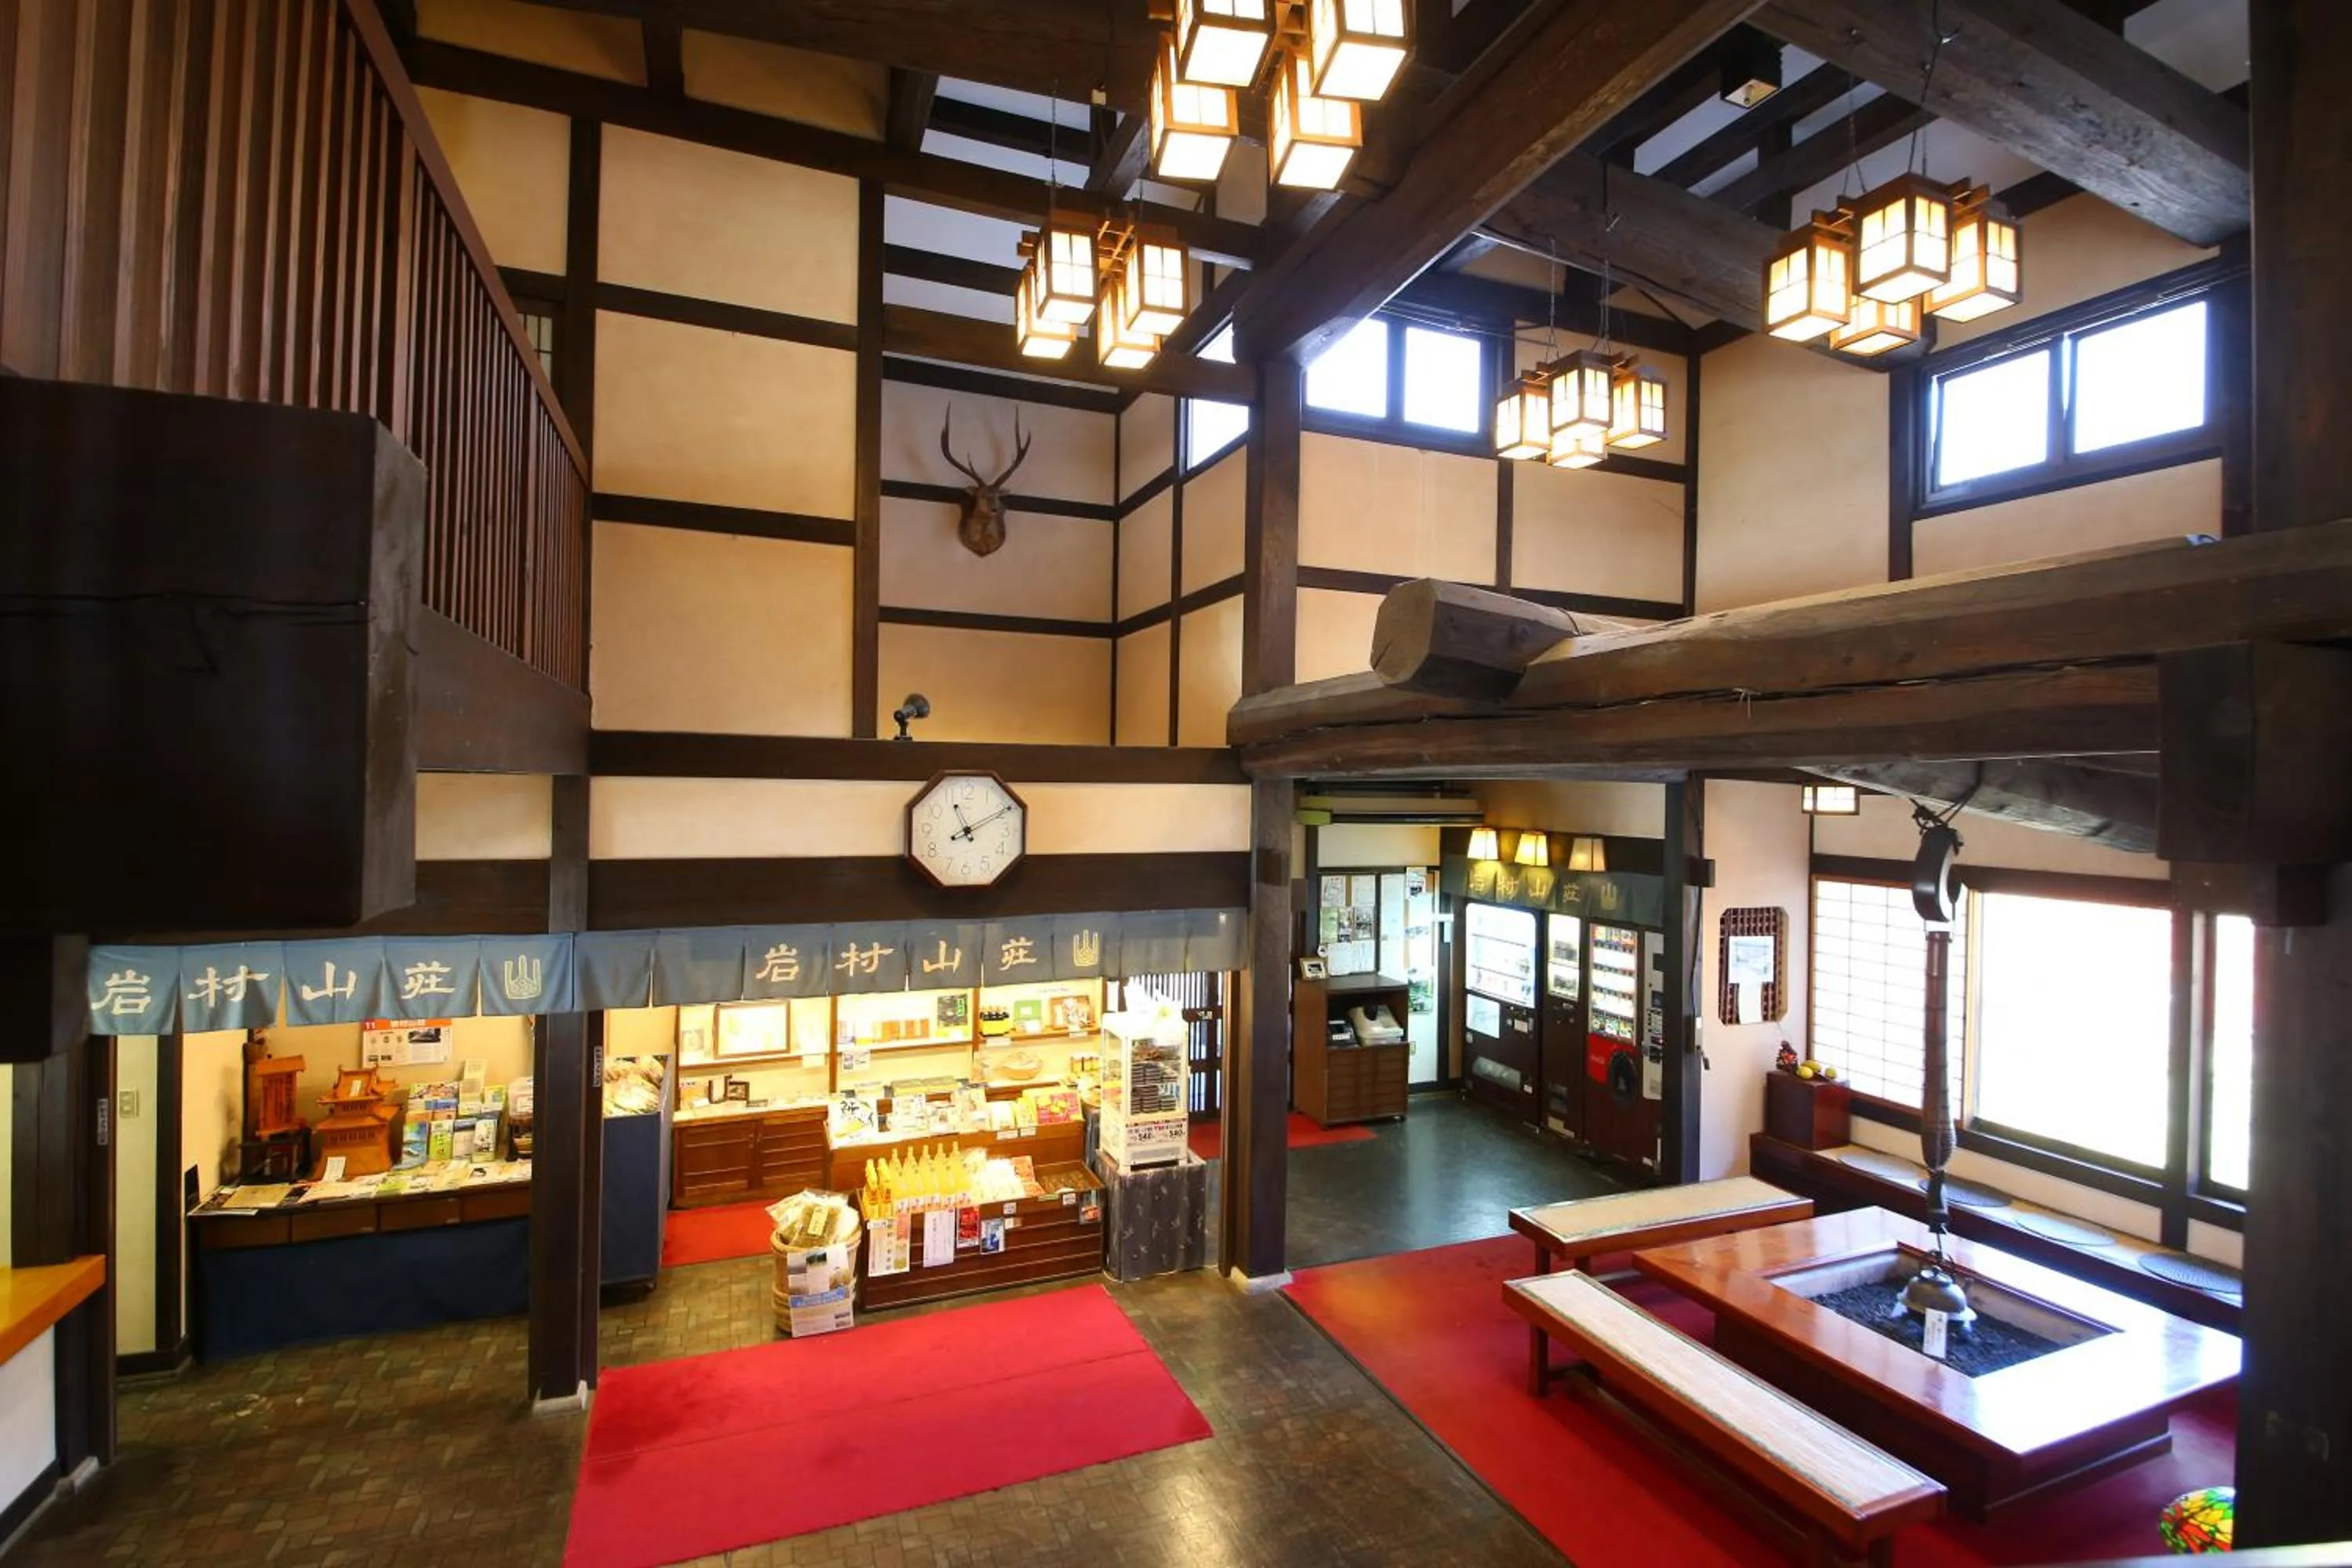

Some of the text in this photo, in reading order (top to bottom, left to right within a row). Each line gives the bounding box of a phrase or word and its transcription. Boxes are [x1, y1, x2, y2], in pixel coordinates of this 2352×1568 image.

[945, 788, 954, 804] 11
[960, 783, 975, 804] 12
[921, 822, 932, 838] 9
[1000, 823, 1011, 839] 3
[927, 841, 937, 858] 8
[995, 841, 1005, 855] 4
[946, 856, 954, 869] 7
[961, 862, 971, 876] 6
[980, 855, 990, 870] 5
[754, 936, 1037, 983] 岩村山荘
[90, 960, 456, 1015] 岩村山荘
